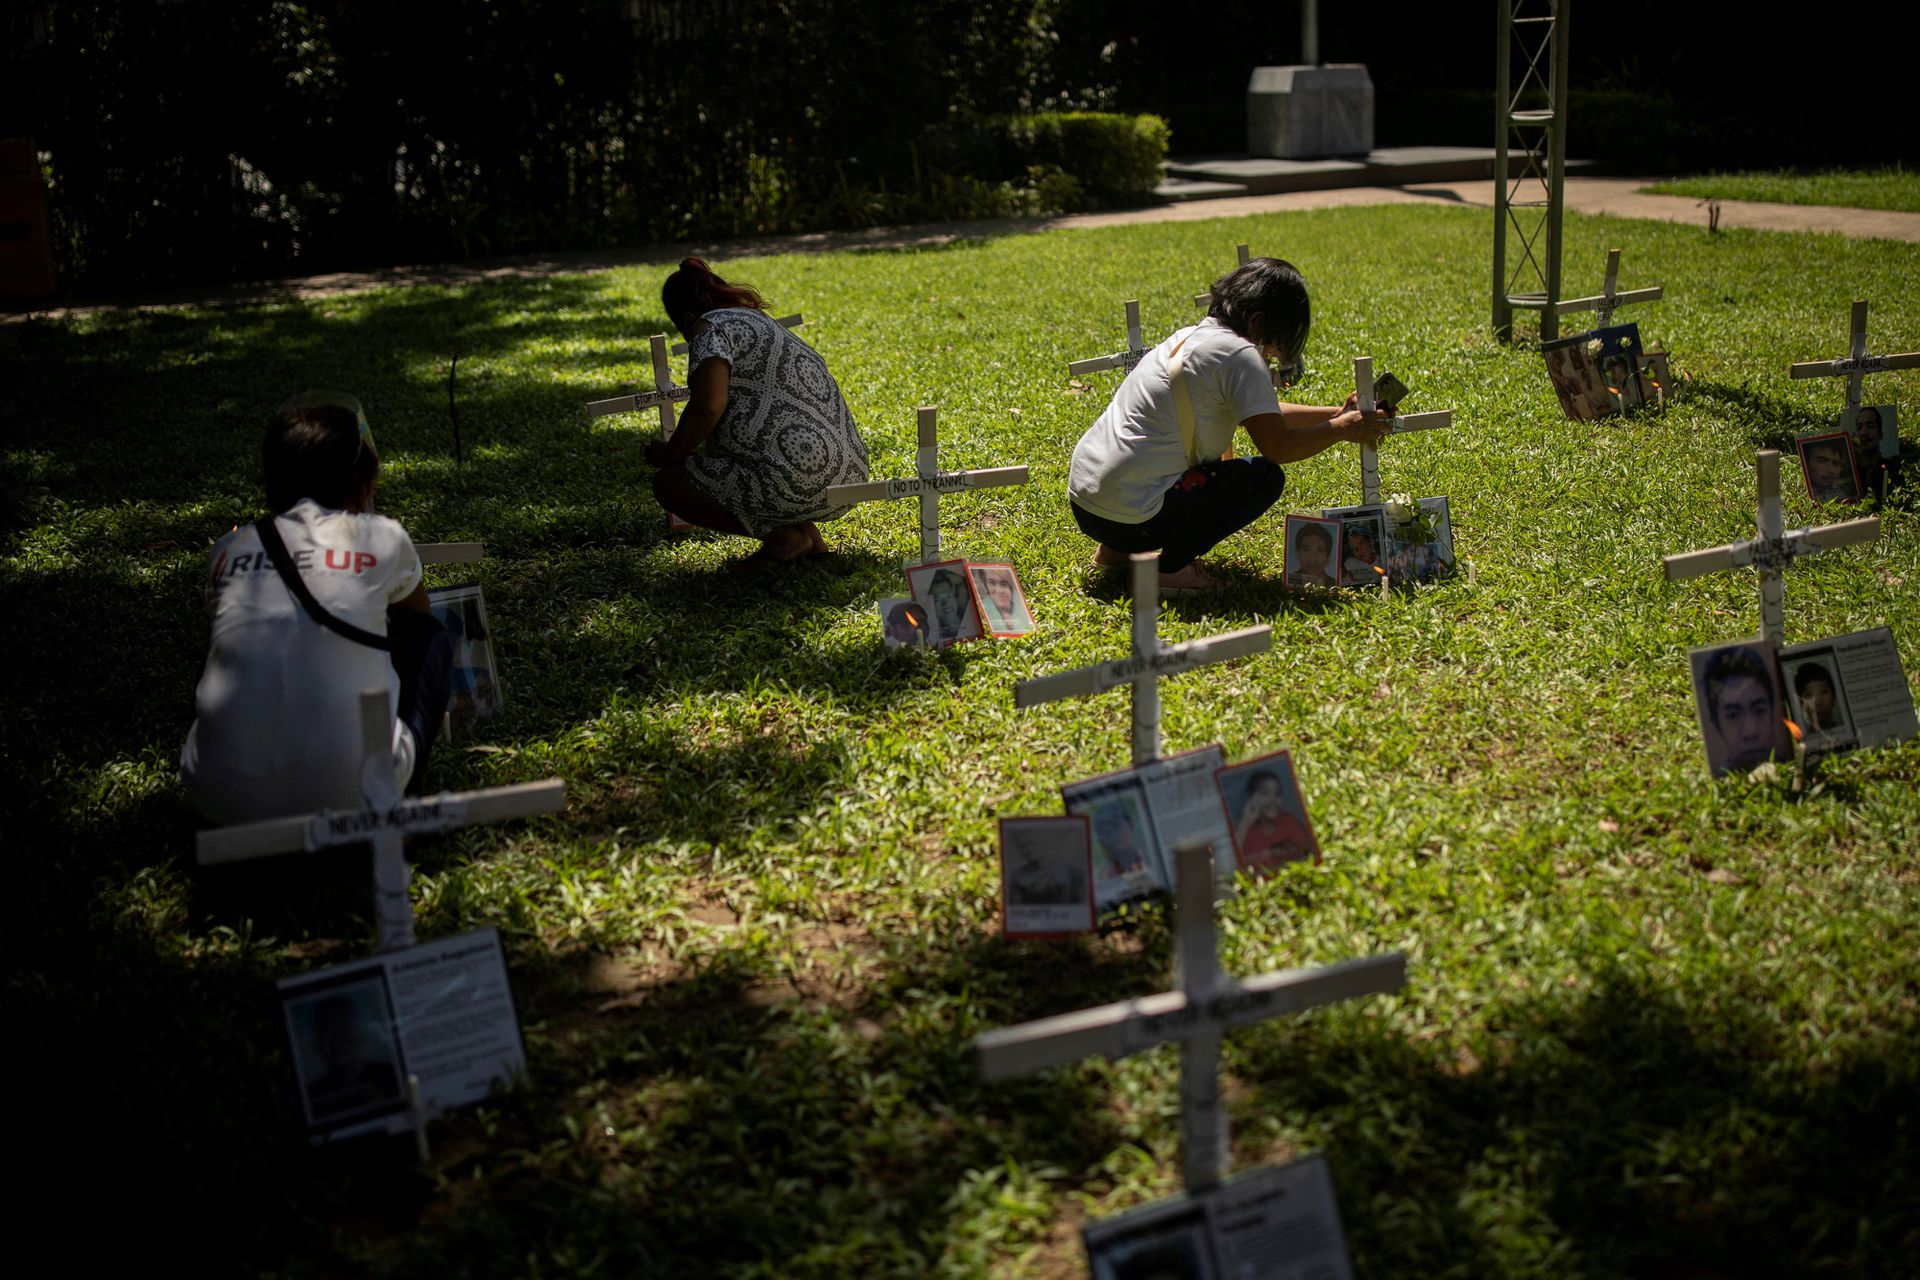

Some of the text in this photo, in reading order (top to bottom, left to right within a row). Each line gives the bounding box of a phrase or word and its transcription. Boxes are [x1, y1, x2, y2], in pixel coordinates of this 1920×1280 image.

[634, 394, 652, 405] STOP
[653, 391, 667, 401] THE
[893, 474, 966, 493] NO TO TYRANNY!
[325, 548, 378, 575] UP
[329, 810, 380, 834] NEVER
